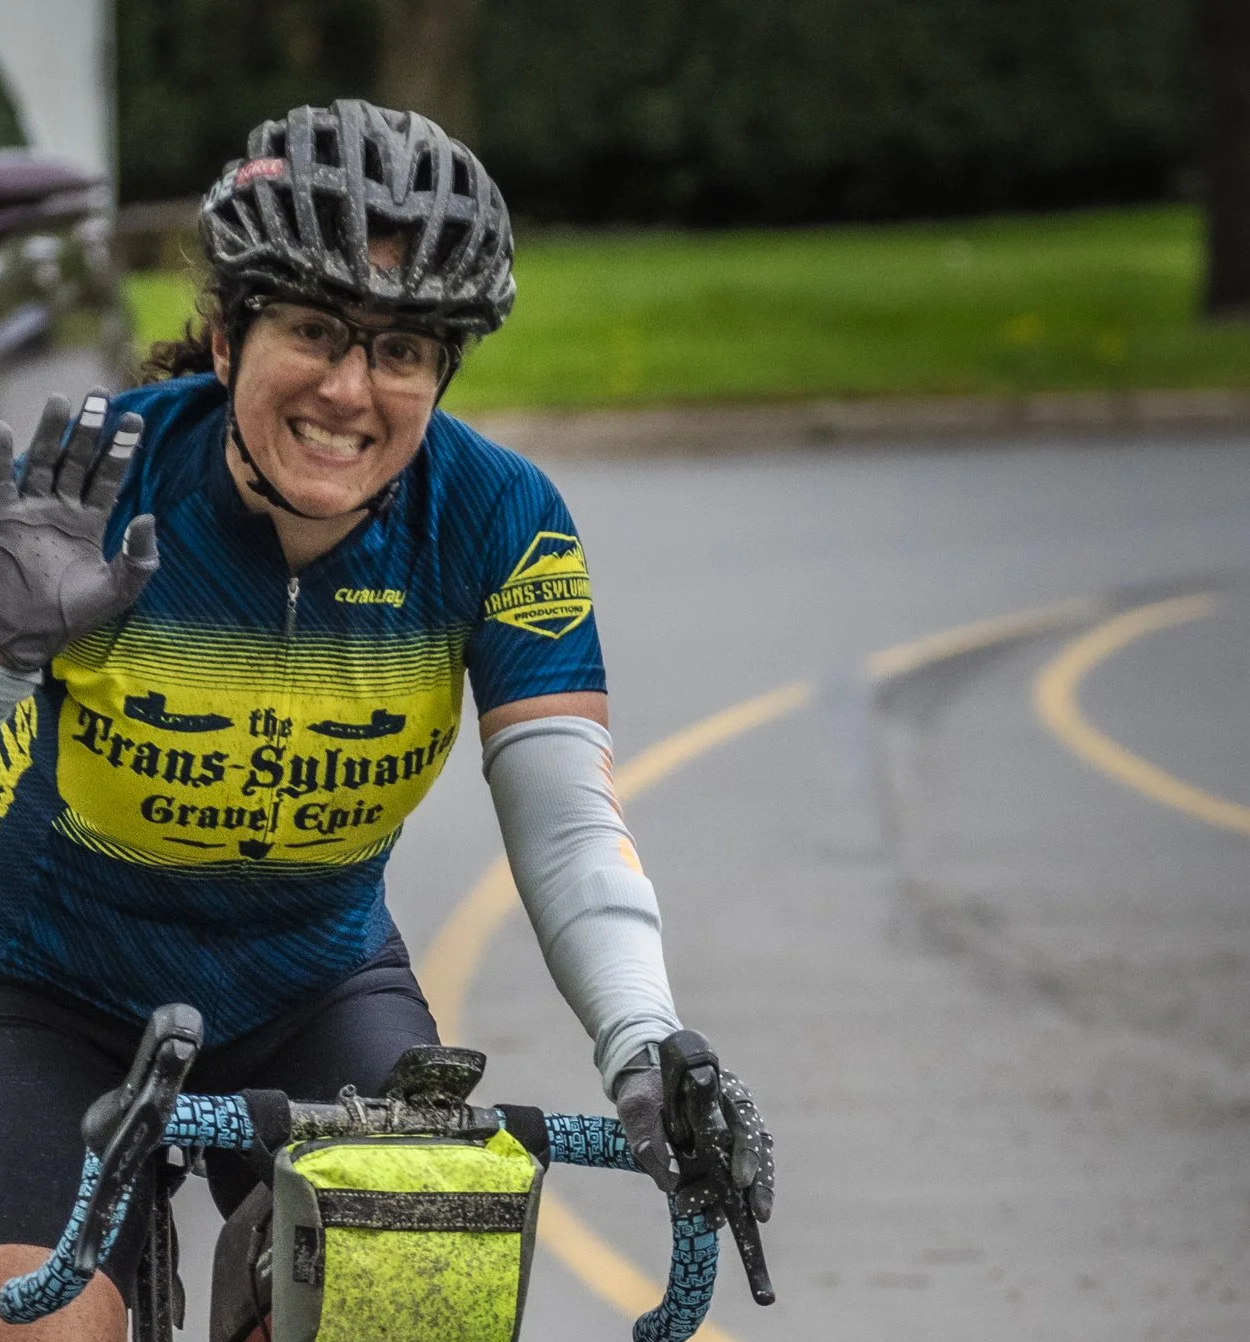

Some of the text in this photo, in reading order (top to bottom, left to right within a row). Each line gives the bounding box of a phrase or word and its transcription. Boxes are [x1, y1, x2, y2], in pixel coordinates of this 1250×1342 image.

[250, 707, 295, 748] the
[141, 794, 385, 835] Gravel Epic
